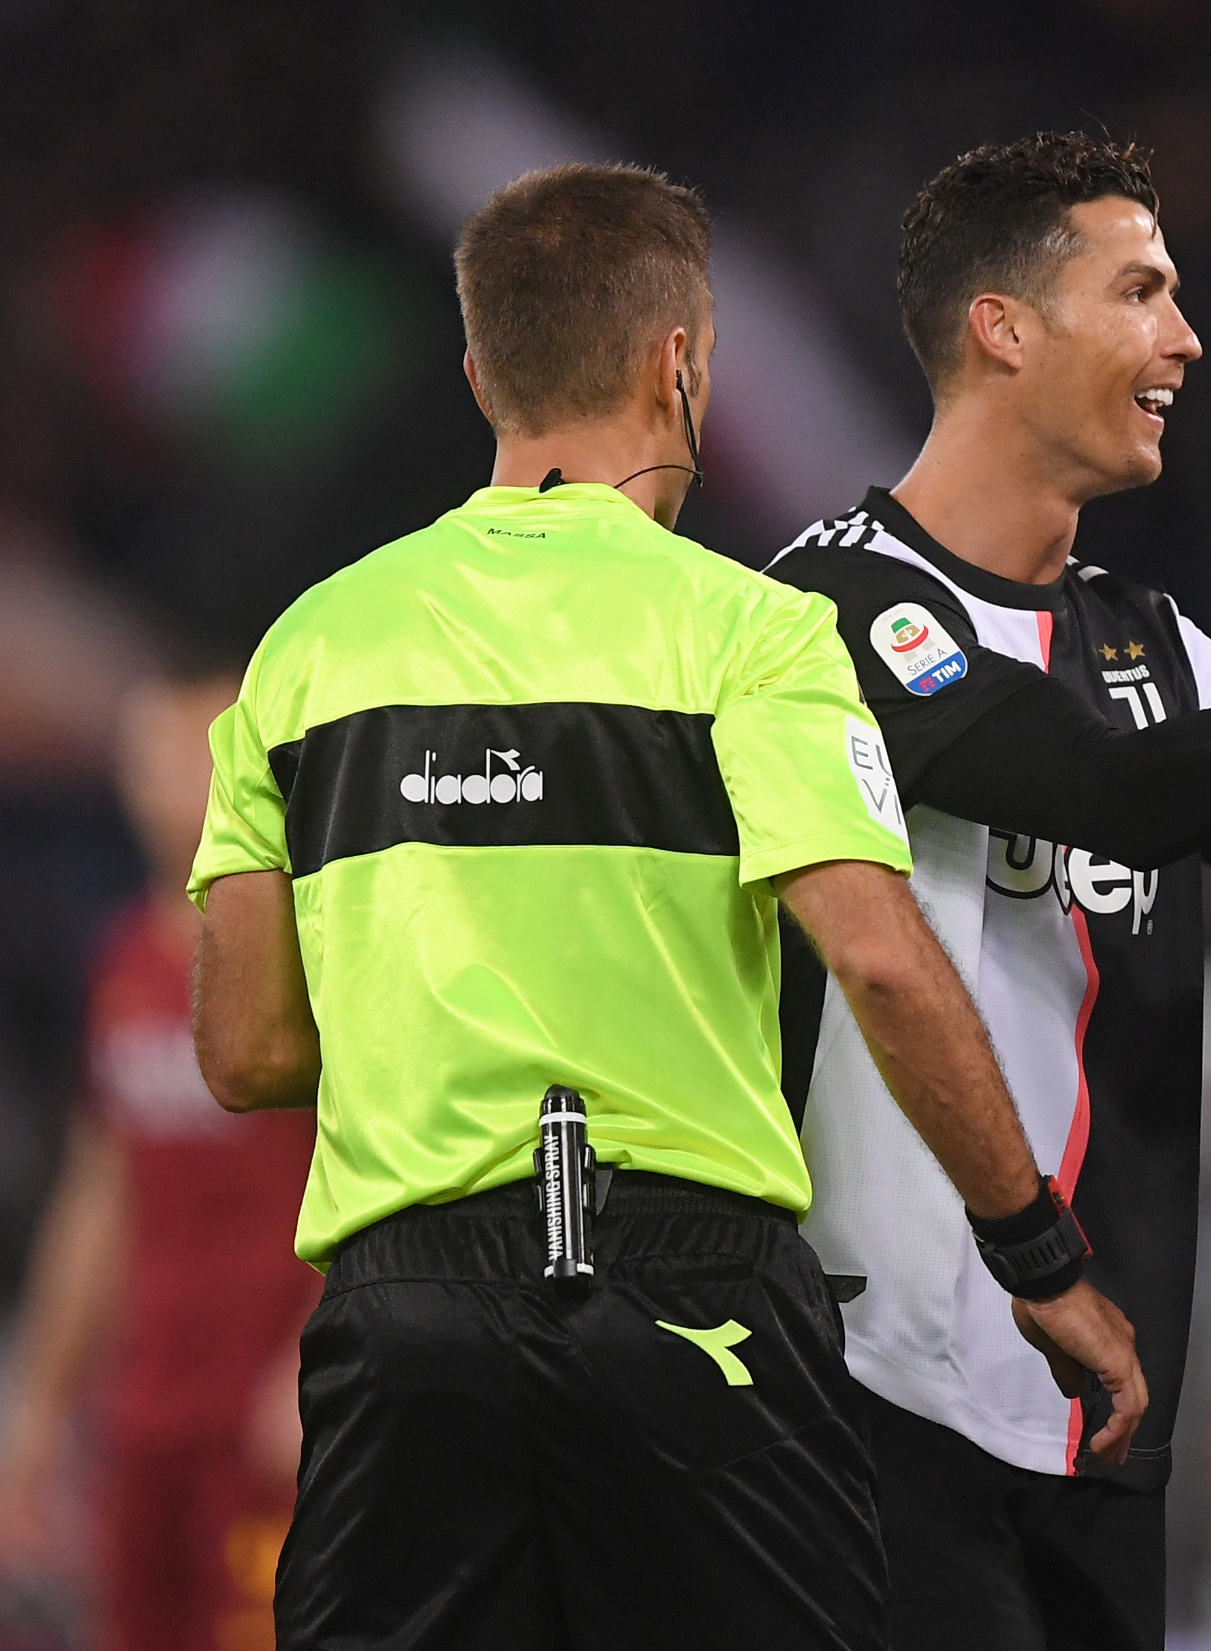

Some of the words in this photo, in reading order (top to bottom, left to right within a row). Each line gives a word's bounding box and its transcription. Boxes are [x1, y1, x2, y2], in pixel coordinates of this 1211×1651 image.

[907, 654, 936, 676] SERIE
[937, 648, 947, 658] A
[931, 660, 962, 683] TIM
[400, 748, 544, 805] diadora
[543, 1134, 561, 1182] SPRAY
[545, 1180, 564, 1261] VANISHING
